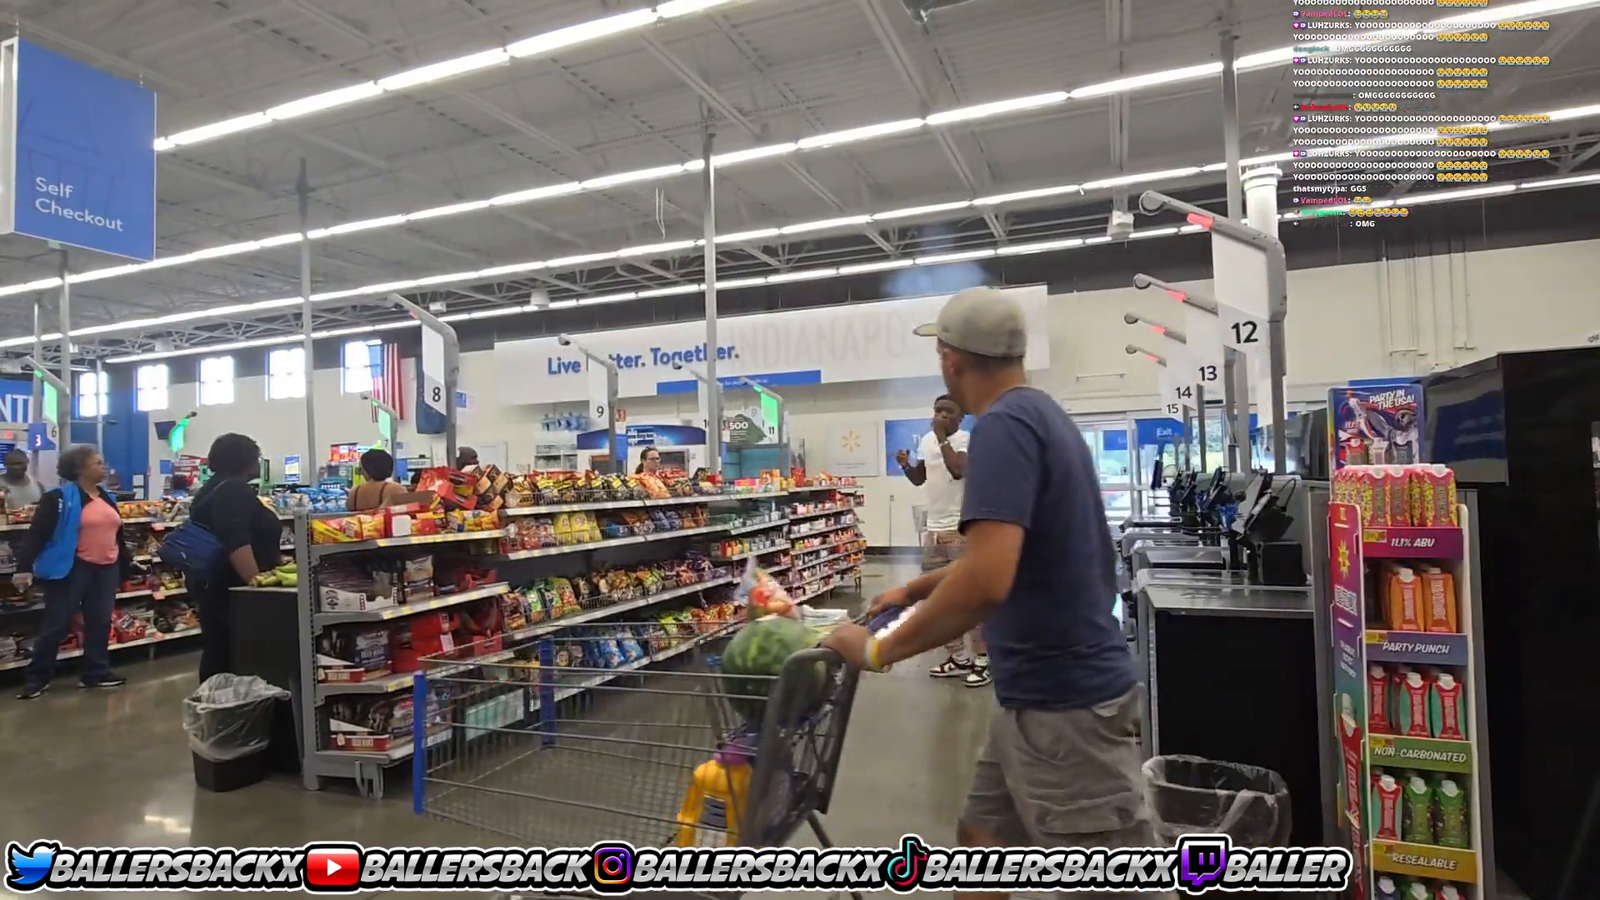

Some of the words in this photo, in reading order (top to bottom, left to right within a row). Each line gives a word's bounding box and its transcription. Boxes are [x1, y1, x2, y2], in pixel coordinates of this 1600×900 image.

[35, 176, 74, 198] Self
[35, 197, 124, 232] Checkout
[1231, 321, 1259, 344] 12
[548, 356, 582, 375] Live
[1199, 365, 1218, 381] 13
[432, 386, 441, 403] 8
[1175, 386, 1192, 400] 14
[1369, 390, 1396, 404] PARTY
[1396, 388, 1405, 398] IN
[596, 405, 605, 418] 9
[1166, 404, 1179, 414] 15
[1378, 398, 1395, 411] THE
[51, 426, 58, 438] 6
[1156, 427, 1173, 437] Exit
[35, 434, 42, 447] 3
[1382, 641, 1415, 653] PARTY
[1415, 643, 1450, 655] PUNCH
[1392, 852, 1457, 870] RESEALABLE
